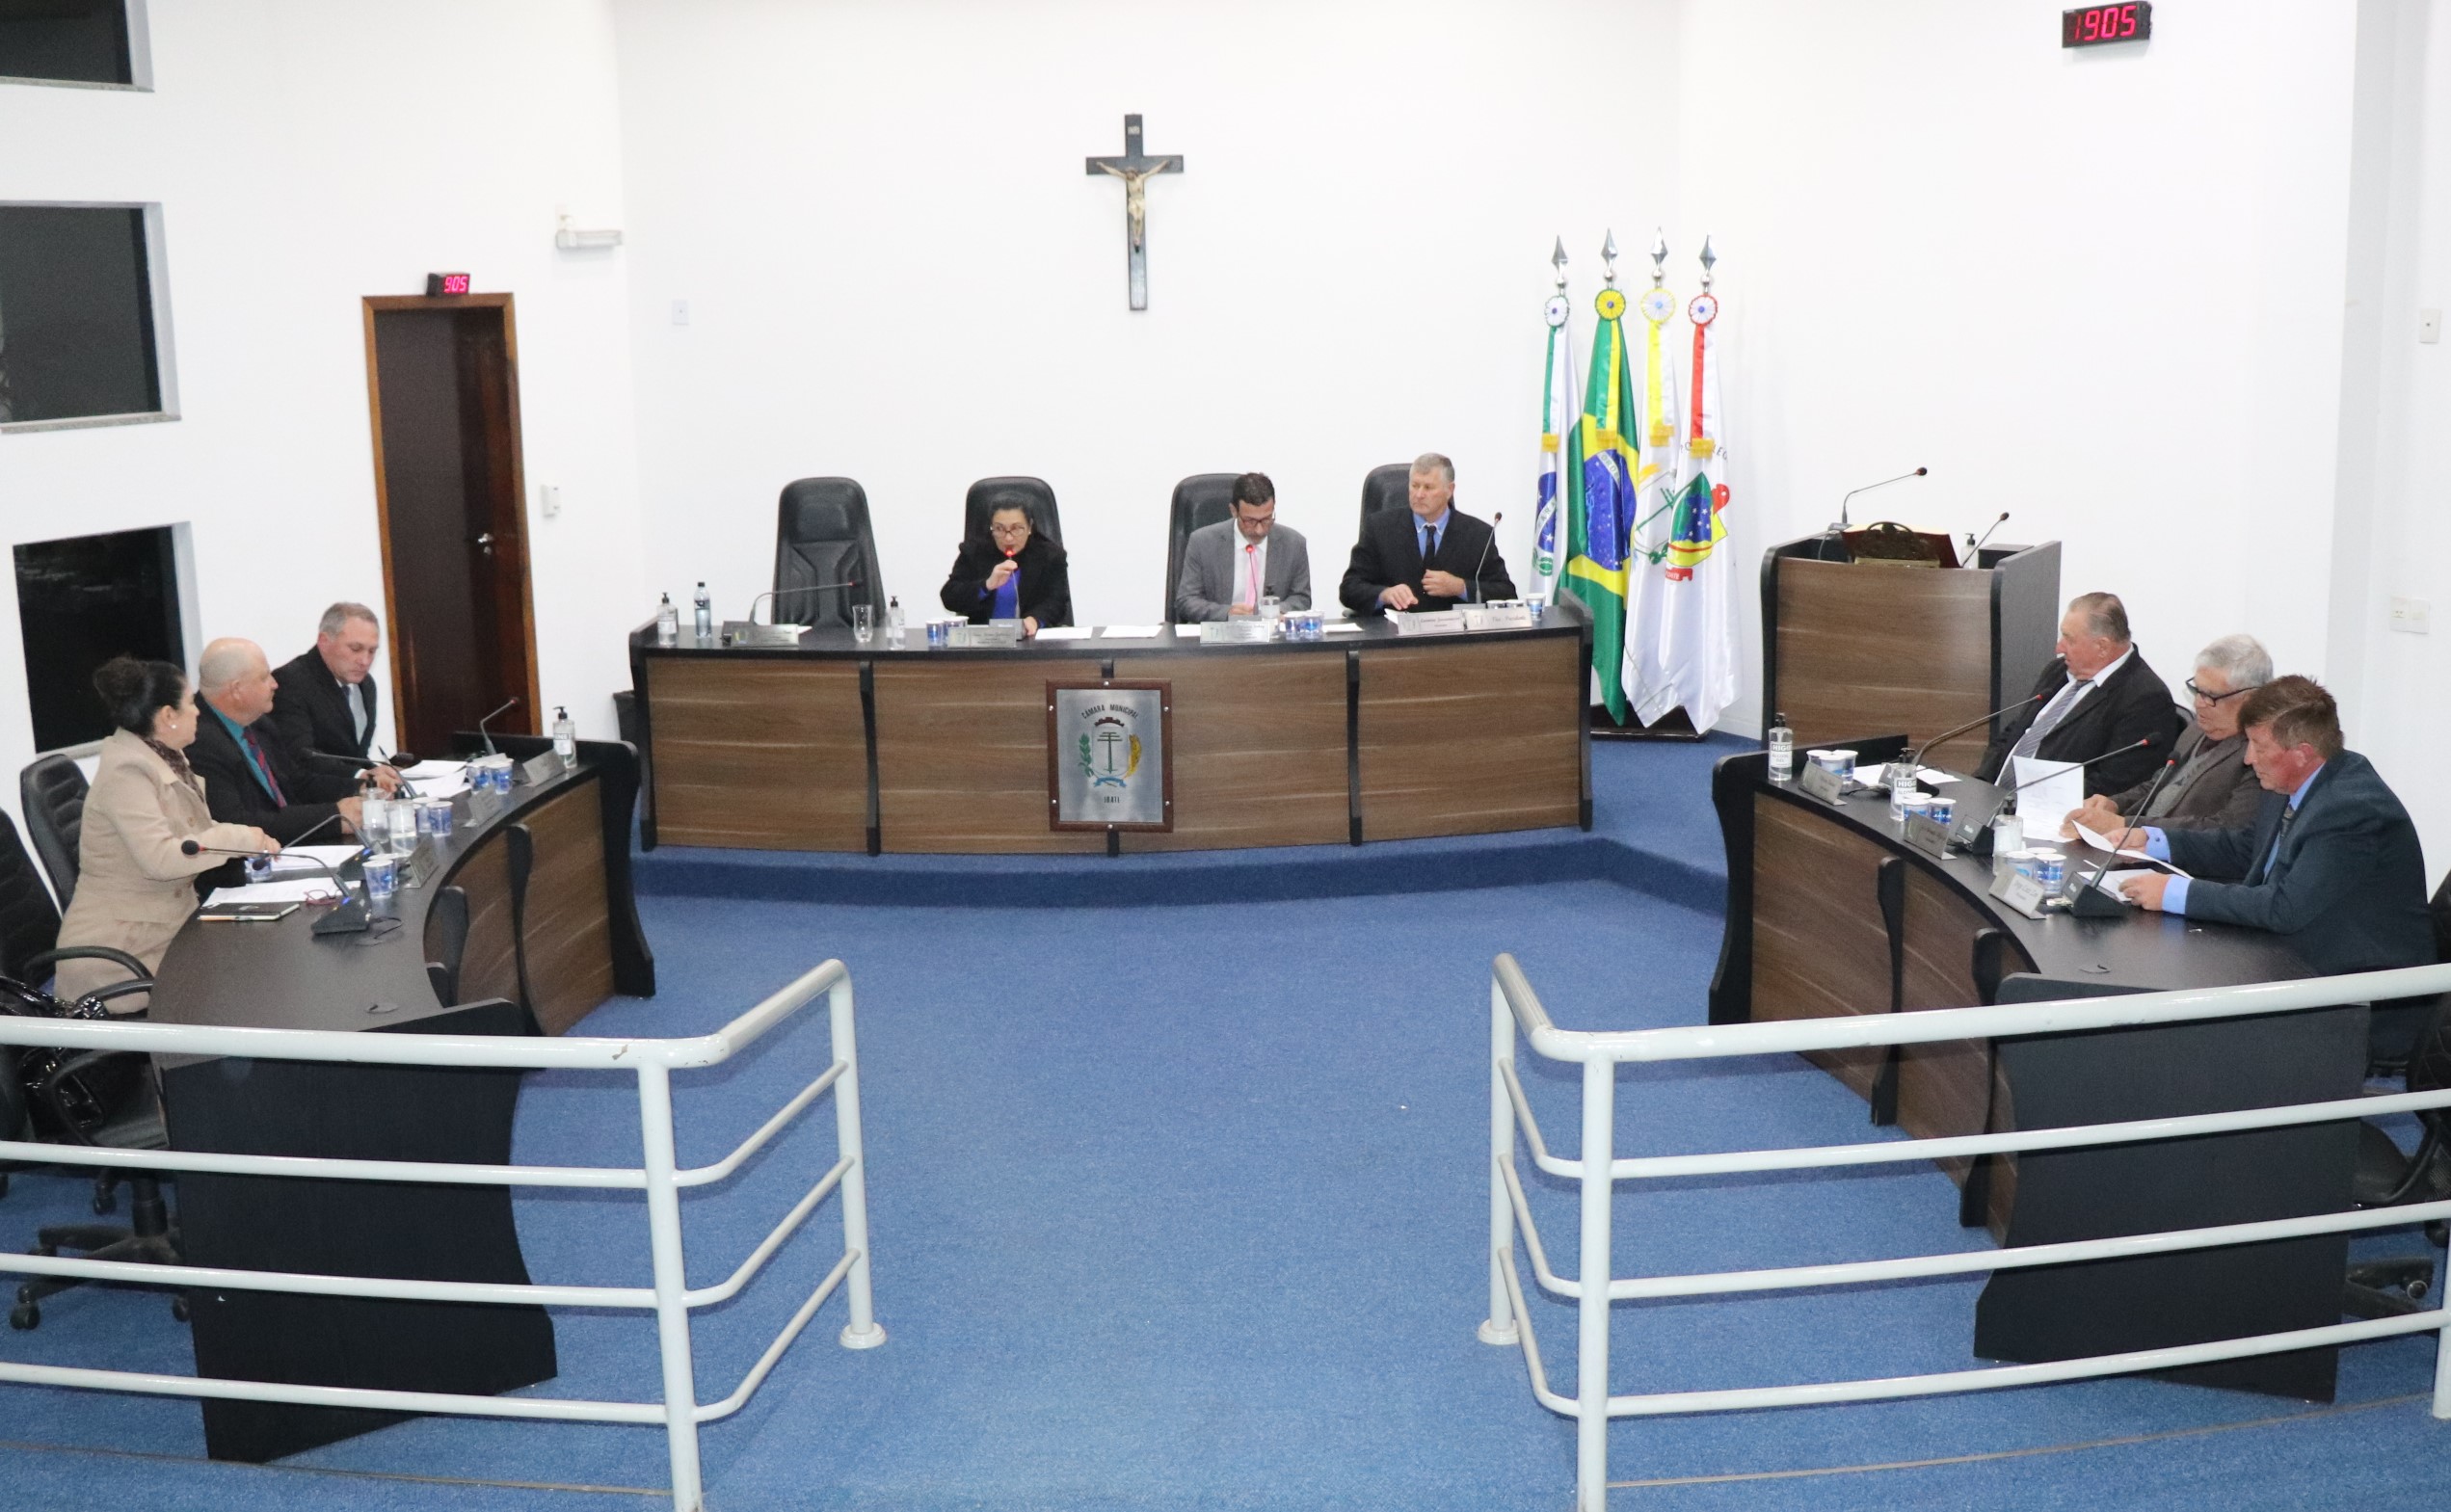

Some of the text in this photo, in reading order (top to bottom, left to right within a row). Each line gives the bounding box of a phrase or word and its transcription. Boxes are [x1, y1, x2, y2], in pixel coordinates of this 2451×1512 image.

[2074, 5, 2137, 41] 1905
[443, 276, 468, 294] 905
[1109, 704, 1139, 720] MUNICIPAL
